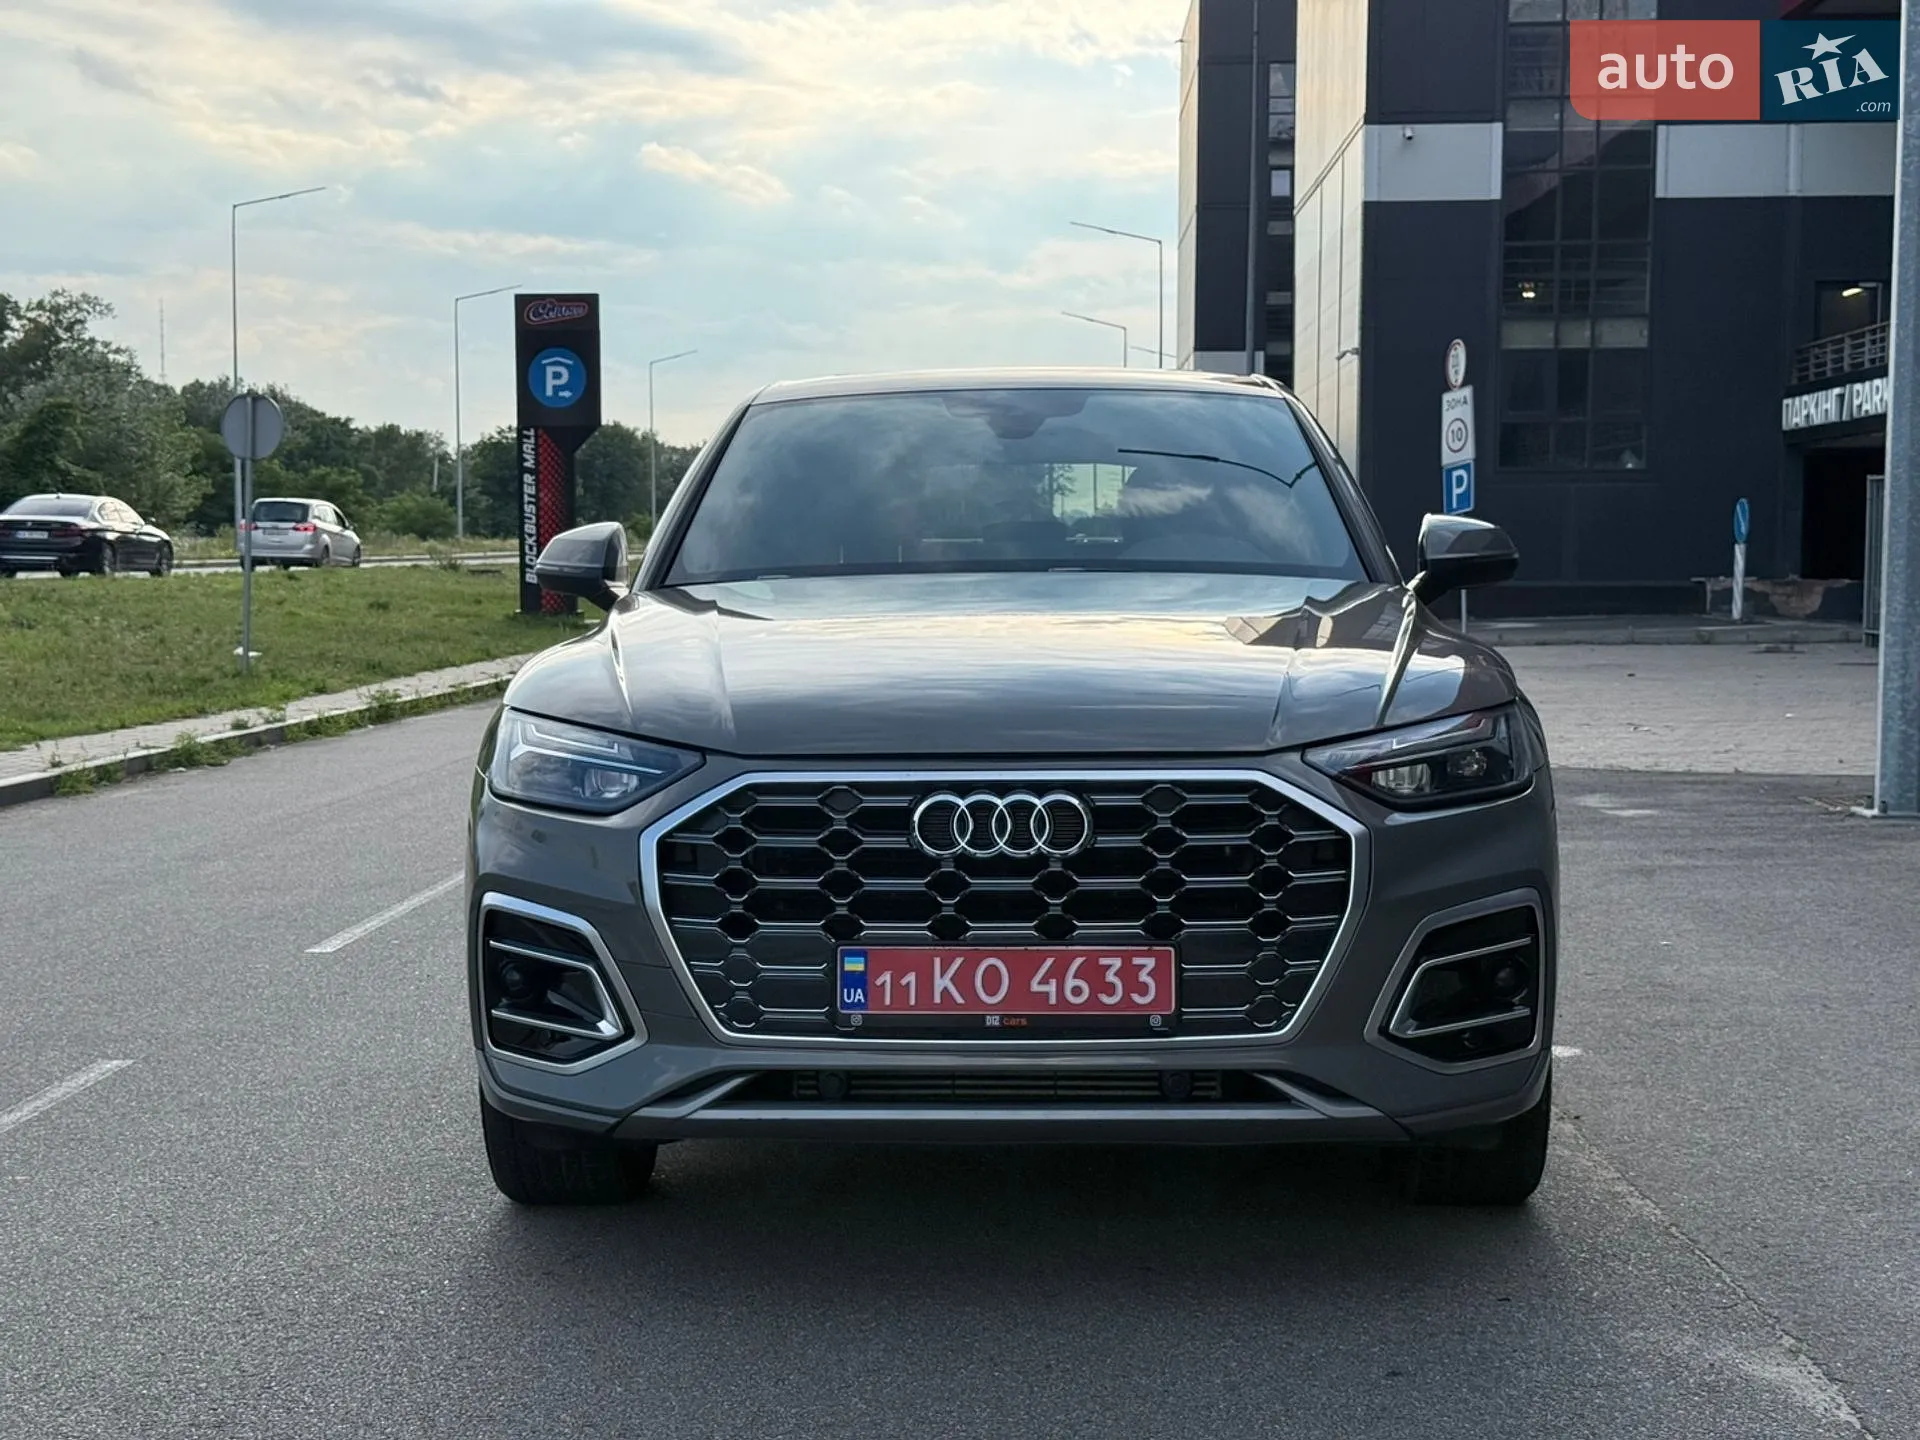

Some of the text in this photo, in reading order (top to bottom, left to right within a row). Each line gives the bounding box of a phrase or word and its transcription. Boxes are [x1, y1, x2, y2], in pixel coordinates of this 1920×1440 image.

[546, 365, 569, 397] P
[1445, 395, 1469, 411] ЗОНА
[1782, 387, 1844, 430] ПАРКІНГ
[1451, 427, 1463, 444] 10
[523, 427, 537, 585] BLOCKBUSTER MALL
[1452, 468, 1468, 509] P
[843, 988, 865, 1003] UA
[874, 956, 1157, 1006] 11 KO 4633
